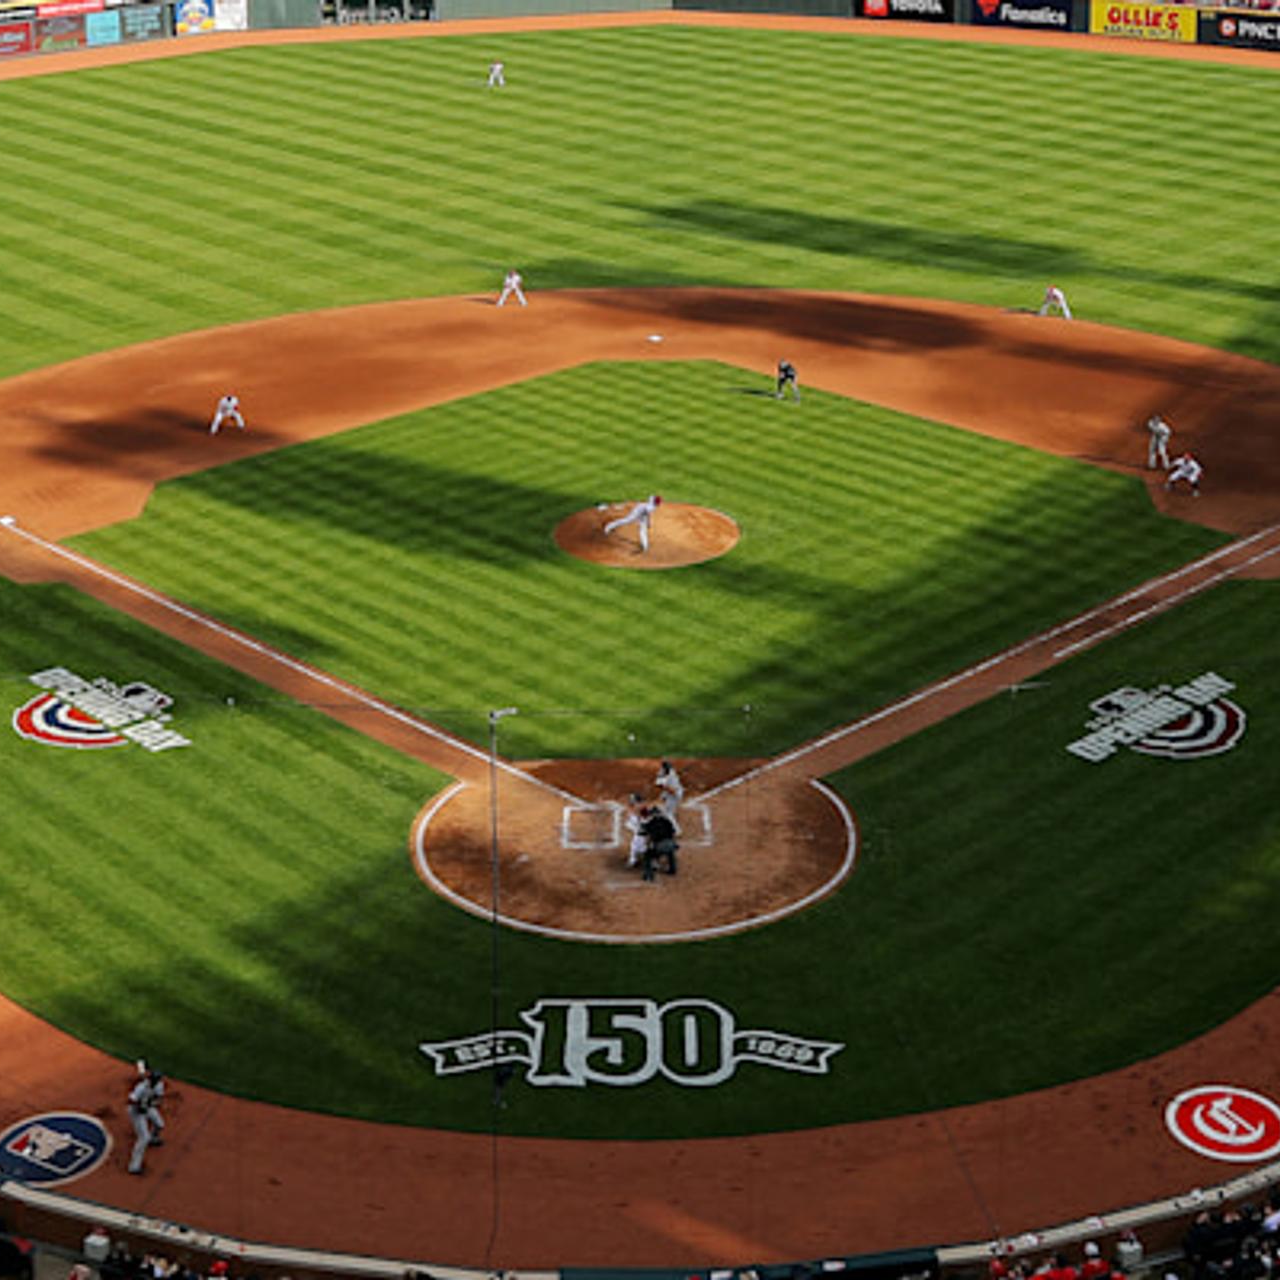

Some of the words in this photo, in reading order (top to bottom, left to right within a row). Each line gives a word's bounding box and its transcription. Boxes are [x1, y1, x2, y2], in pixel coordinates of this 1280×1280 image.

[1000, 3, 1067, 25] Fanatics
[1107, 6, 1179, 31] OLLIE'S
[528, 1002, 728, 1082] 150
